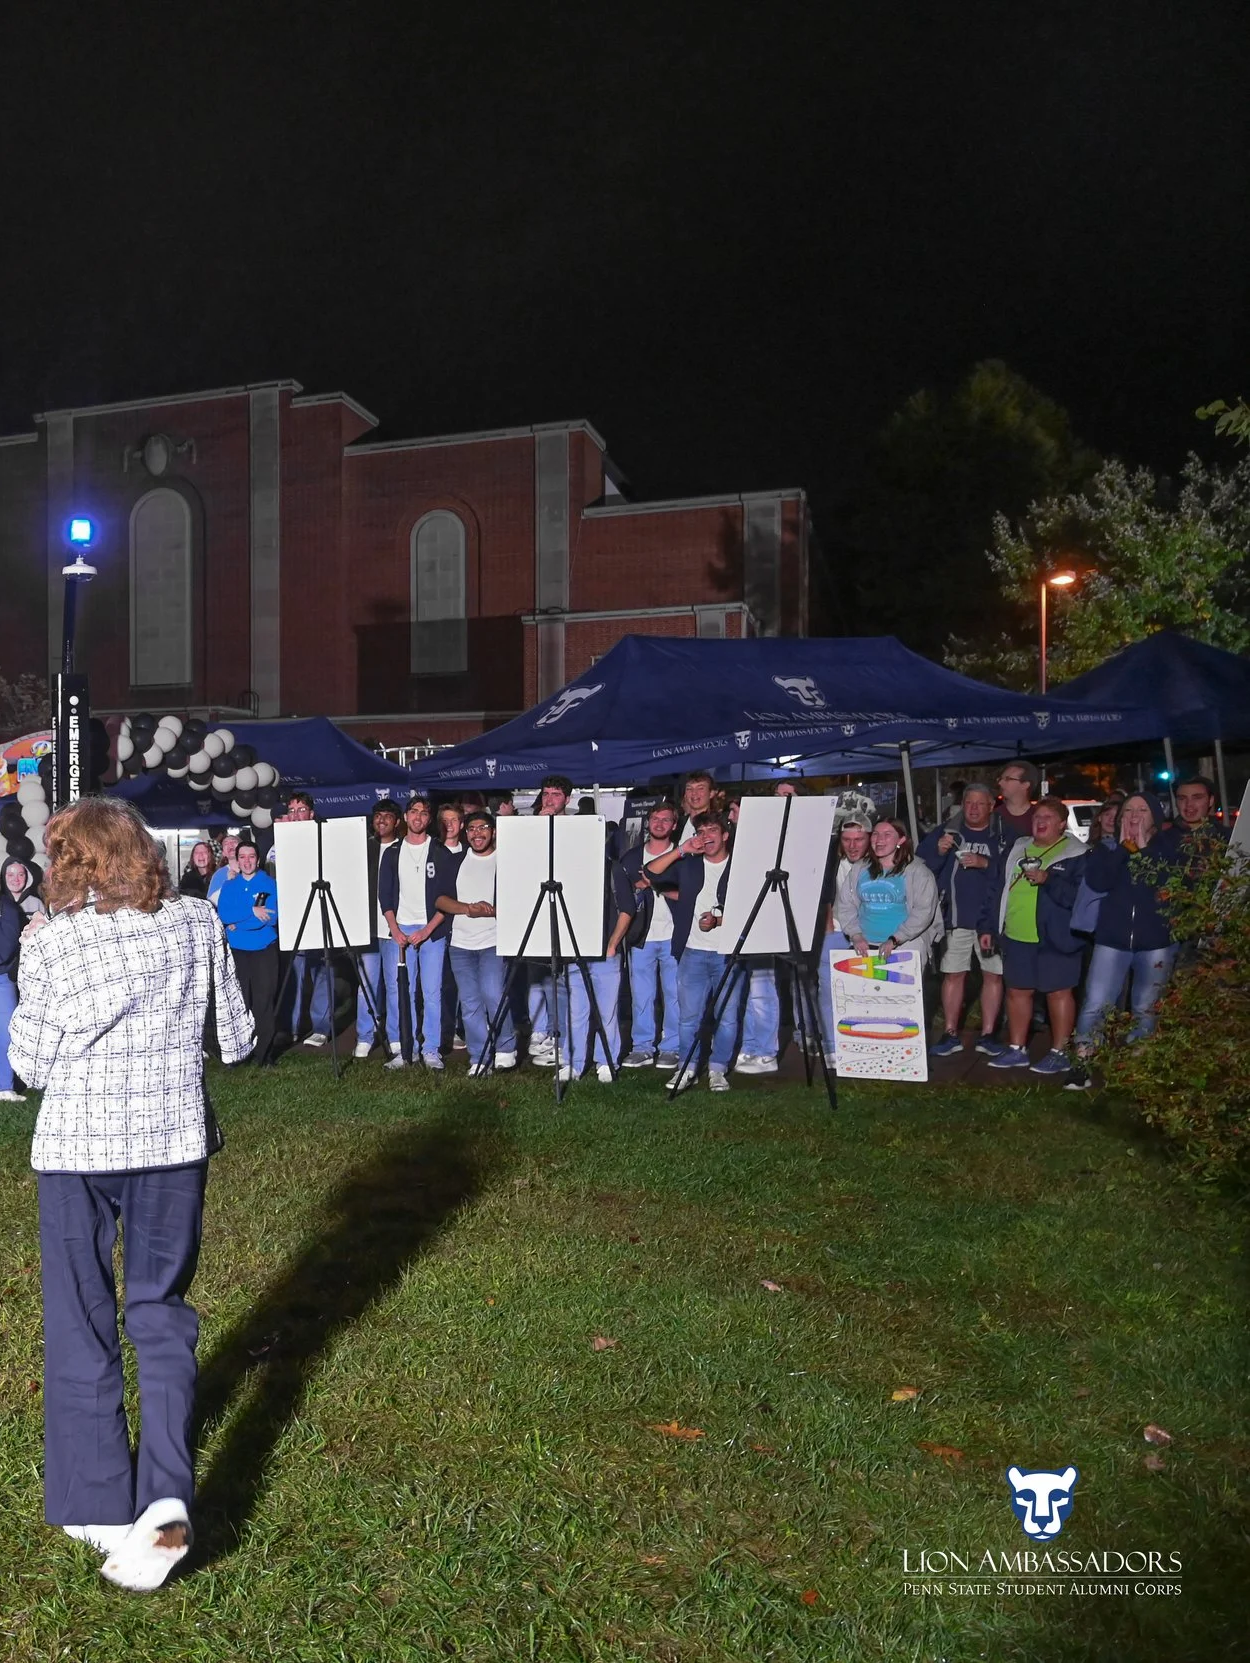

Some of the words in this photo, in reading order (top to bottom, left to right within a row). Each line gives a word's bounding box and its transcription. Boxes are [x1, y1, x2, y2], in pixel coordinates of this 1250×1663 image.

[743, 711, 789, 721] LION
[757, 731, 777, 741] LION
[652, 748, 674, 758] LION
[68, 715, 81, 803] EMERGEN
